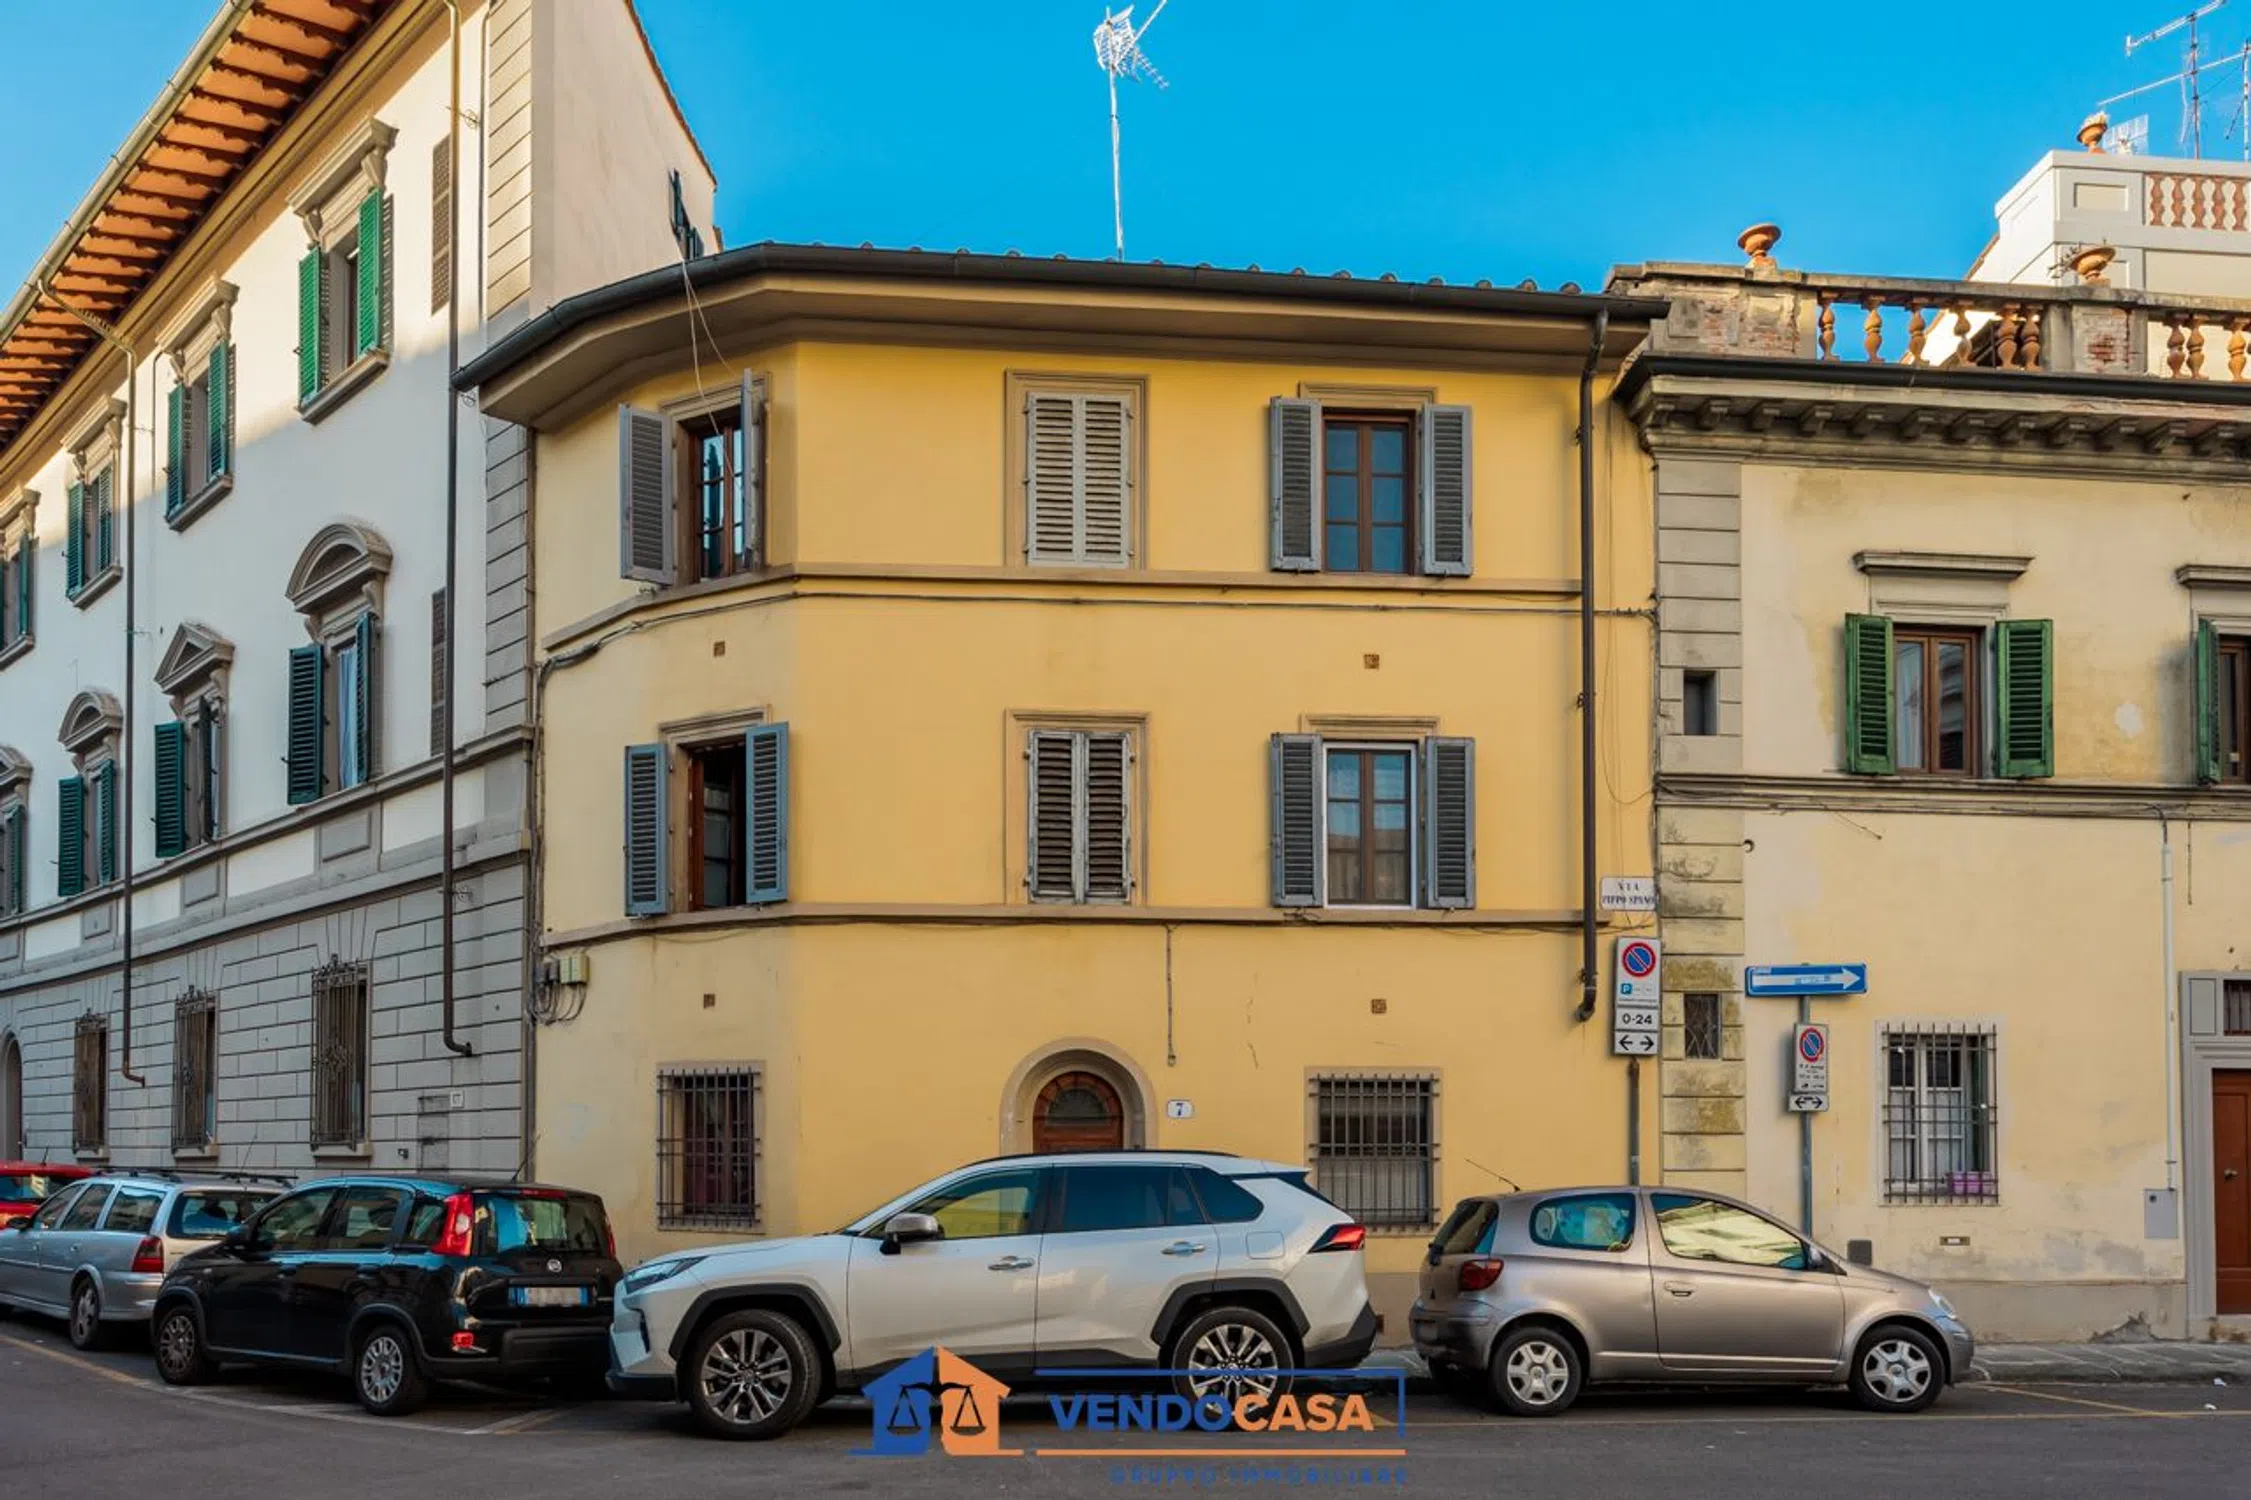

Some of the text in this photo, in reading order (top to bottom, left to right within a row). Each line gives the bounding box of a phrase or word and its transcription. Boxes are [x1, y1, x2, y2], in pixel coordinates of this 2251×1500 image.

[1617, 882, 1640, 891] VIA
[1622, 1013, 1652, 1025] 0-24
[1175, 1102, 1184, 1116] 7
